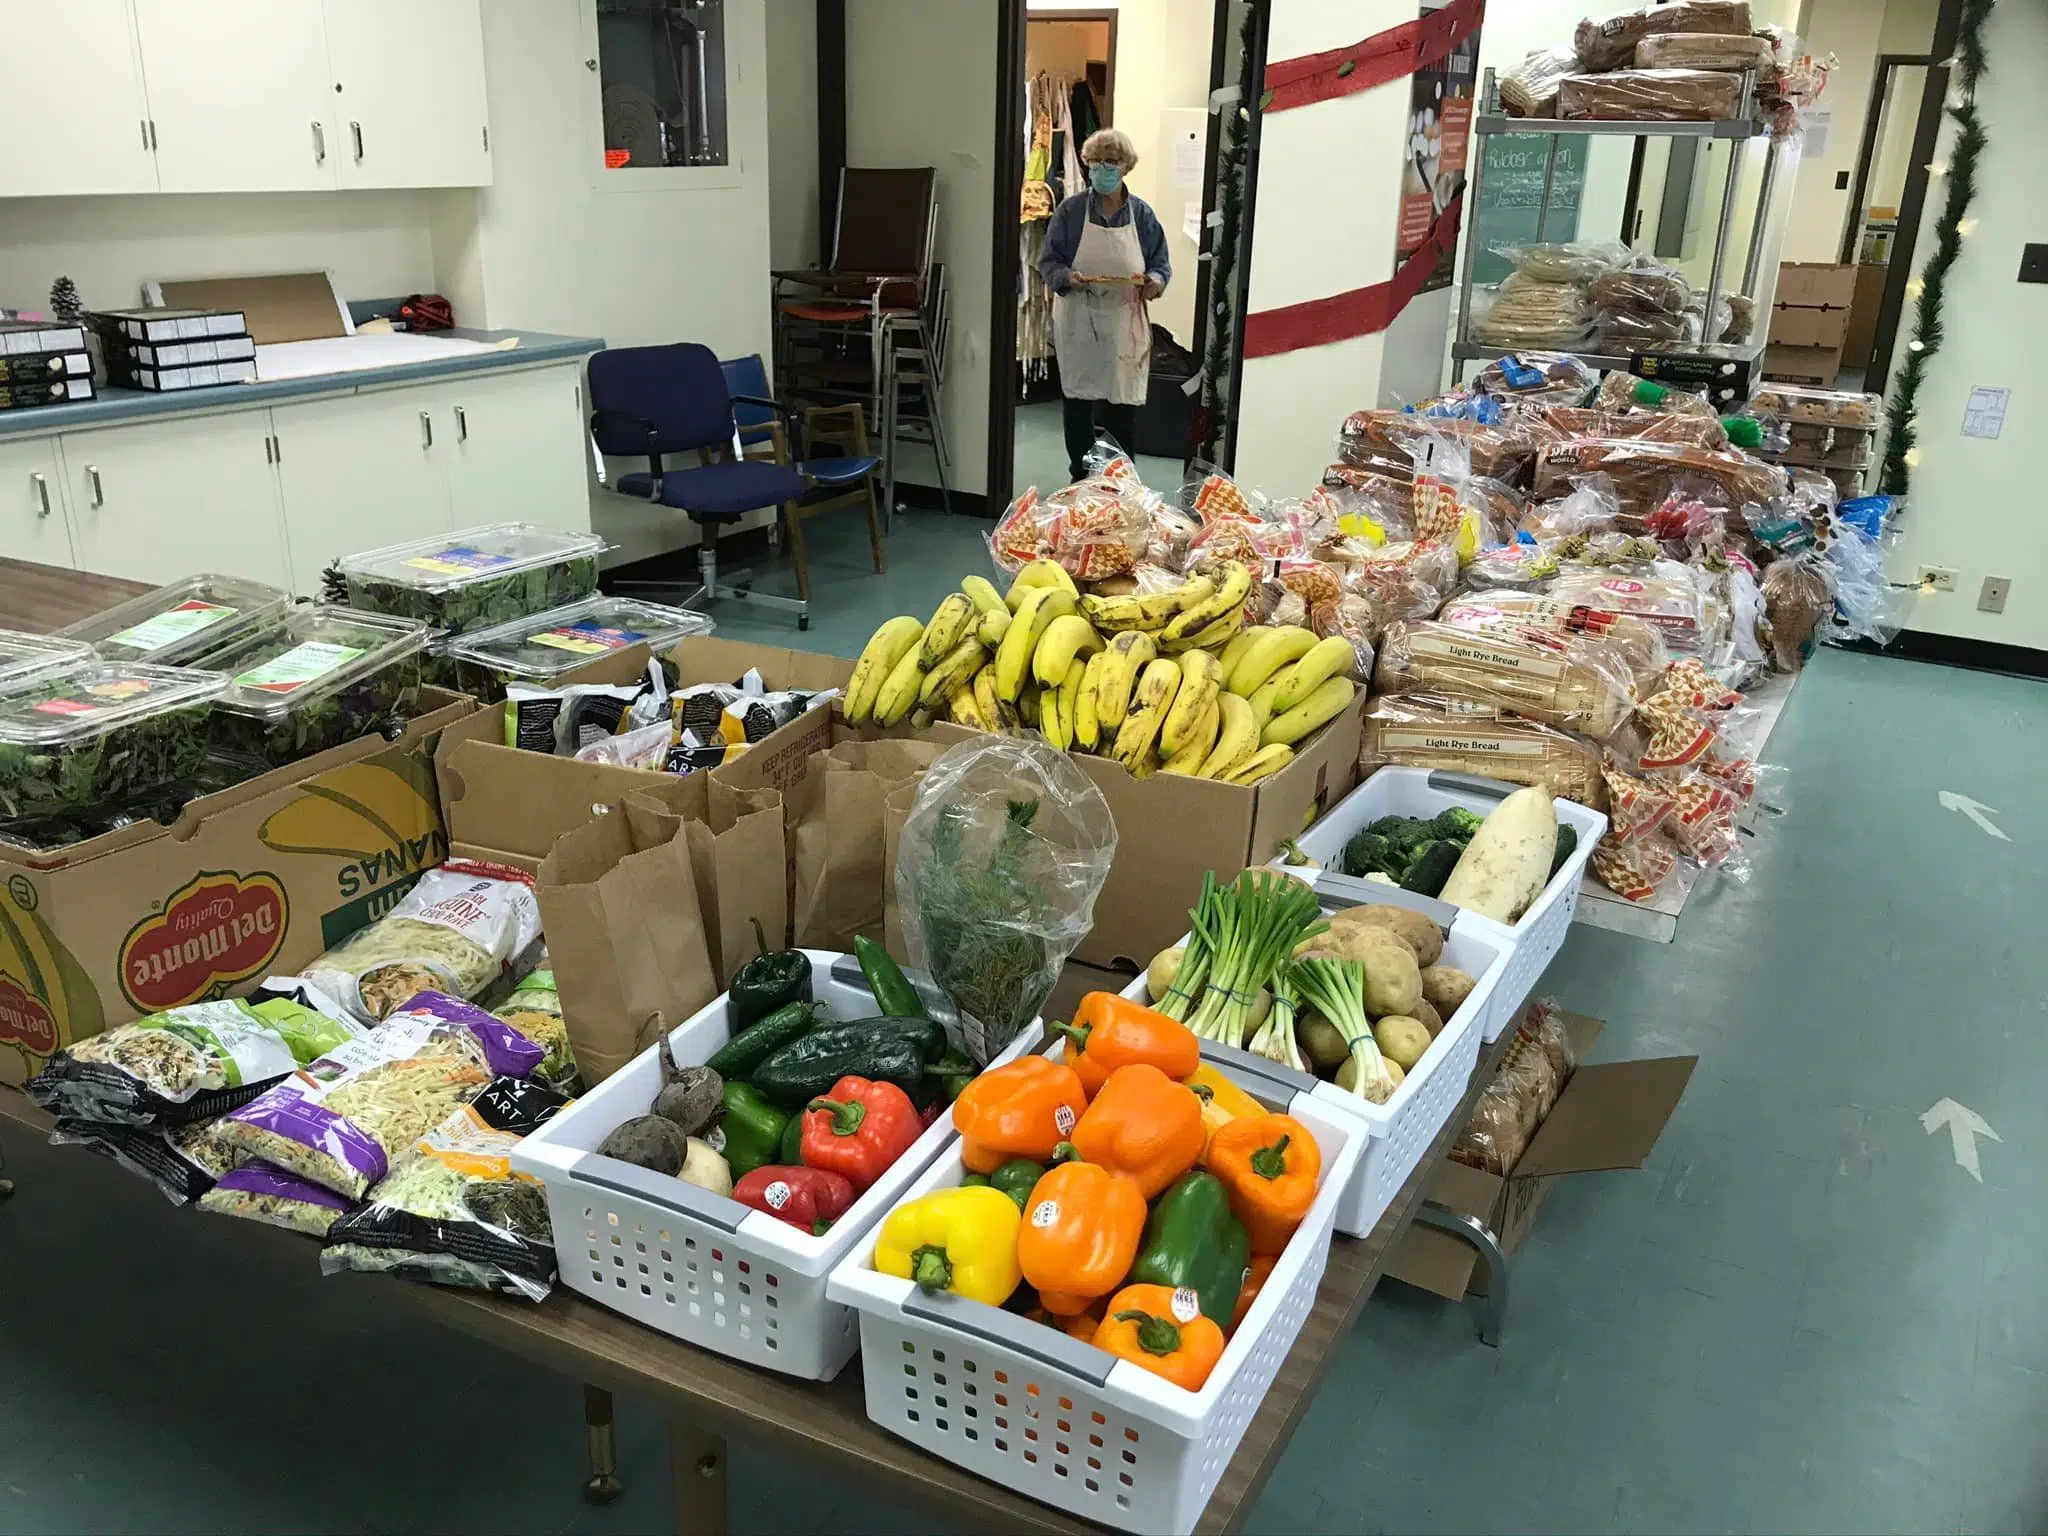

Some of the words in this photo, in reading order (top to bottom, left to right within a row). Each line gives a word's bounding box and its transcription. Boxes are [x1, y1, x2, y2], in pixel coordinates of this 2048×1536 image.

[1449, 645, 1471, 658] Light
[1473, 650, 1490, 661] Rye
[1492, 655, 1519, 667] Bread
[1425, 738, 1449, 750] Light
[1451, 740, 1470, 751] Rye
[1471, 740, 1500, 751] Bread
[762, 752, 780, 776] KEEP
[338, 830, 447, 898] NANAS
[176, 898, 235, 932] Quality
[230, 902, 277, 948] Del
[486, 1090, 523, 1121] ART
